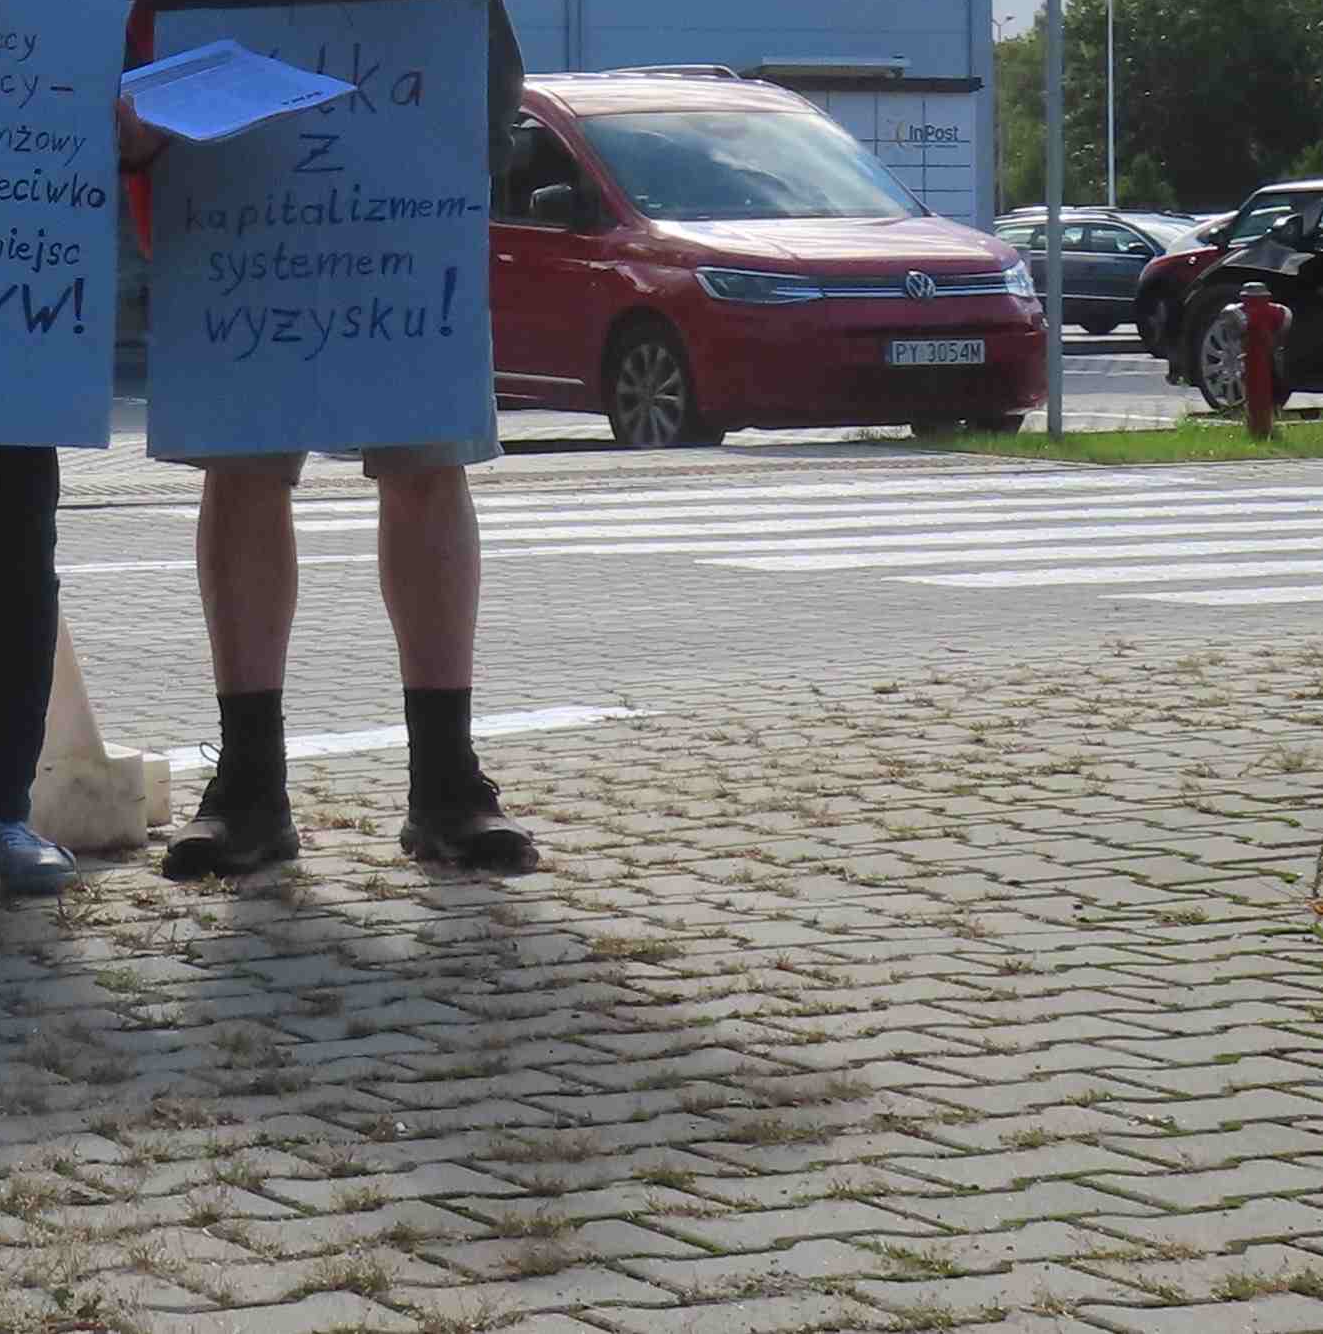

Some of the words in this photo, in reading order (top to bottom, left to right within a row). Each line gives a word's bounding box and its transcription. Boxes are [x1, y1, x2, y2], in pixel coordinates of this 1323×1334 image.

[909, 125, 959, 140] InPost
[208, 242, 413, 296] systemem
[896, 343, 920, 363] PY
